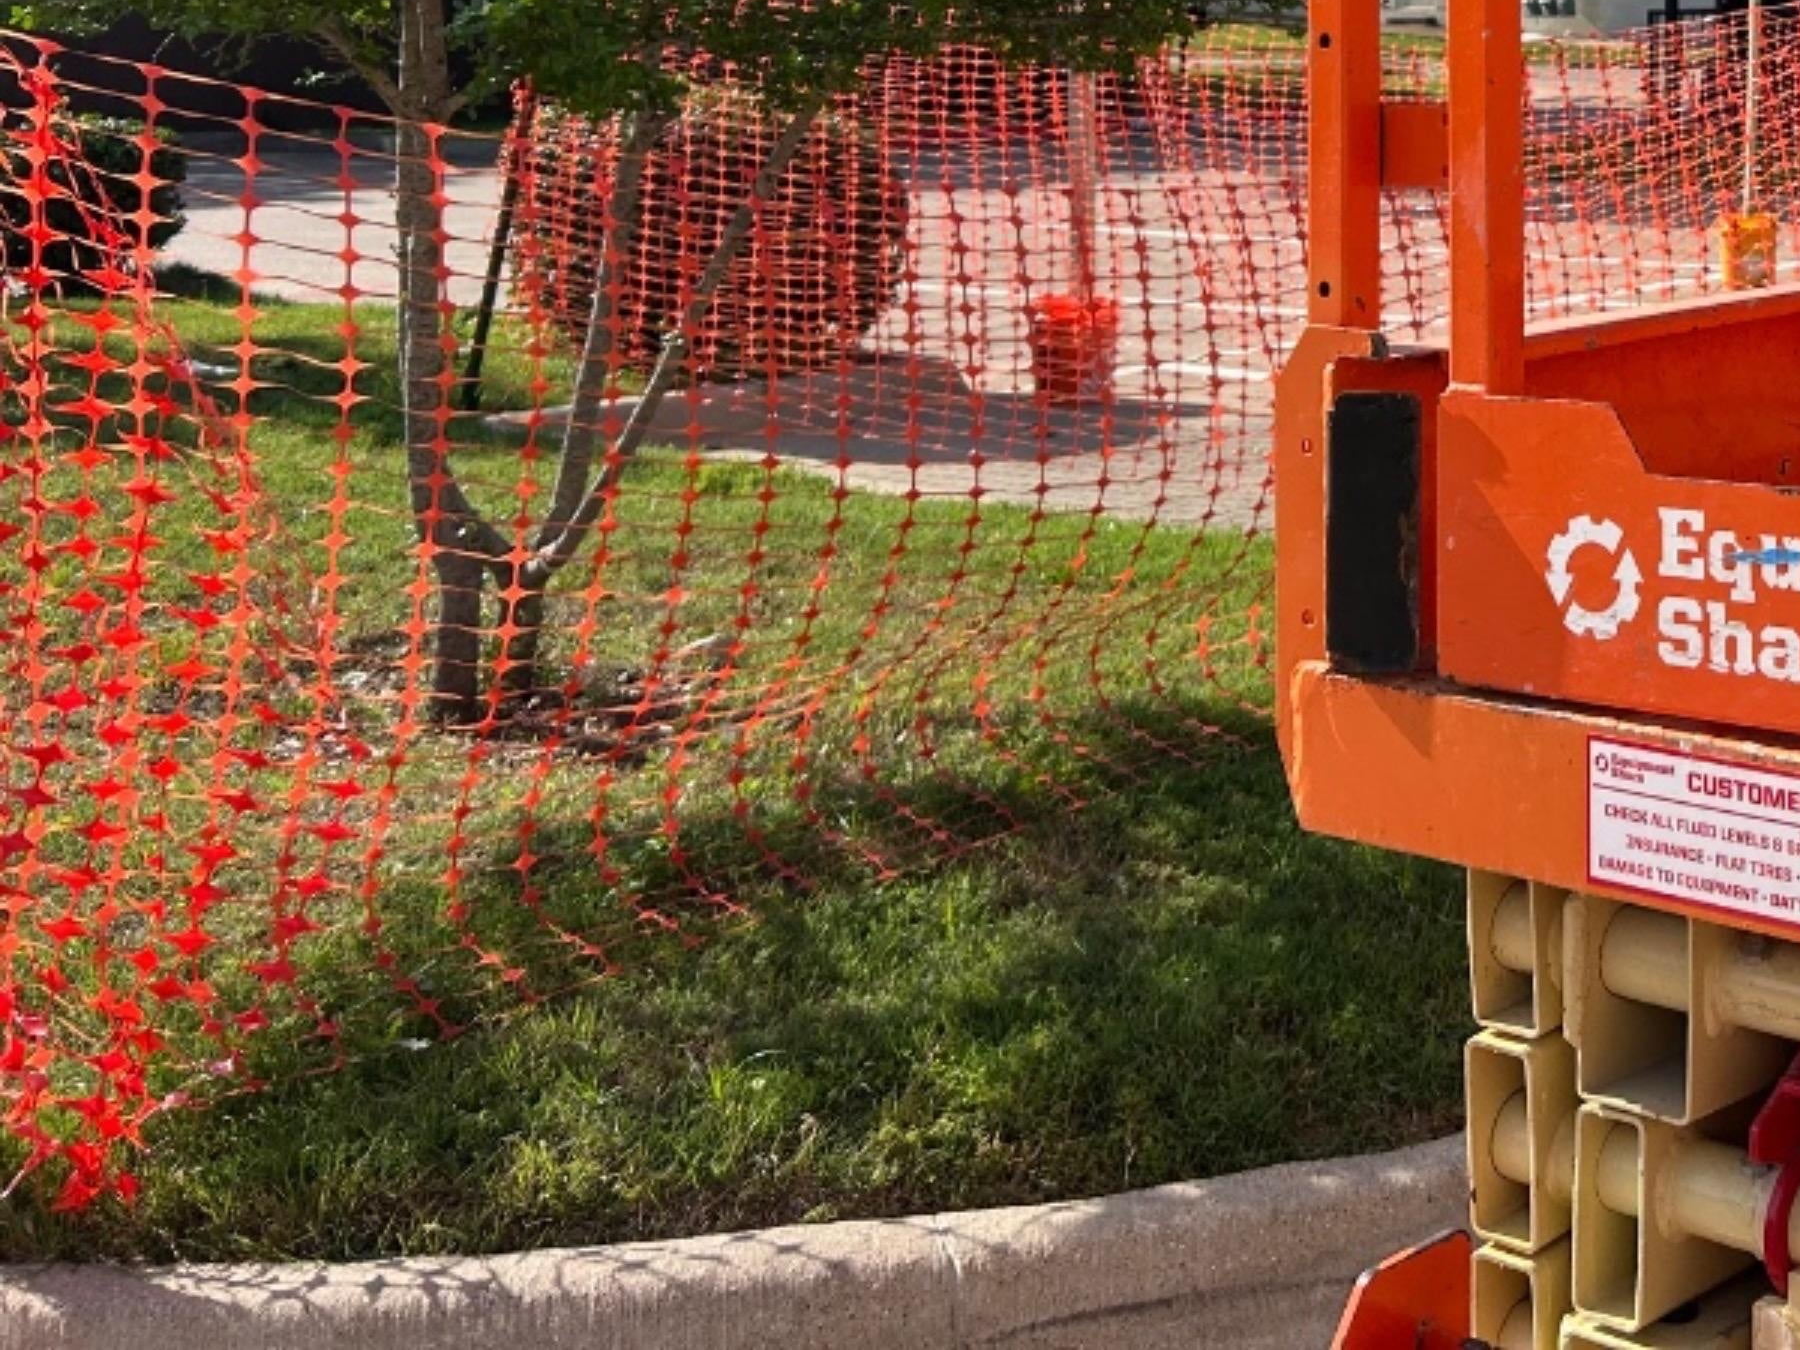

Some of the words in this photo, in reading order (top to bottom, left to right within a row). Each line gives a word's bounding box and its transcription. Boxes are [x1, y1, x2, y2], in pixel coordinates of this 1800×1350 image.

[1604, 803, 1647, 826] CHECK
[1650, 811, 1673, 830] ALL
[1677, 817, 1717, 838] FLUID
[1721, 826, 1770, 850] LEVELS
[1598, 854, 1653, 880] DAMAGE
[1655, 866, 1674, 883] TO
[1676, 871, 1760, 901] EQUIPMENT
[1625, 833, 1705, 865] INSURANCE
[1715, 853, 1747, 871] FLAT
[1749, 860, 1793, 882] TIRES
